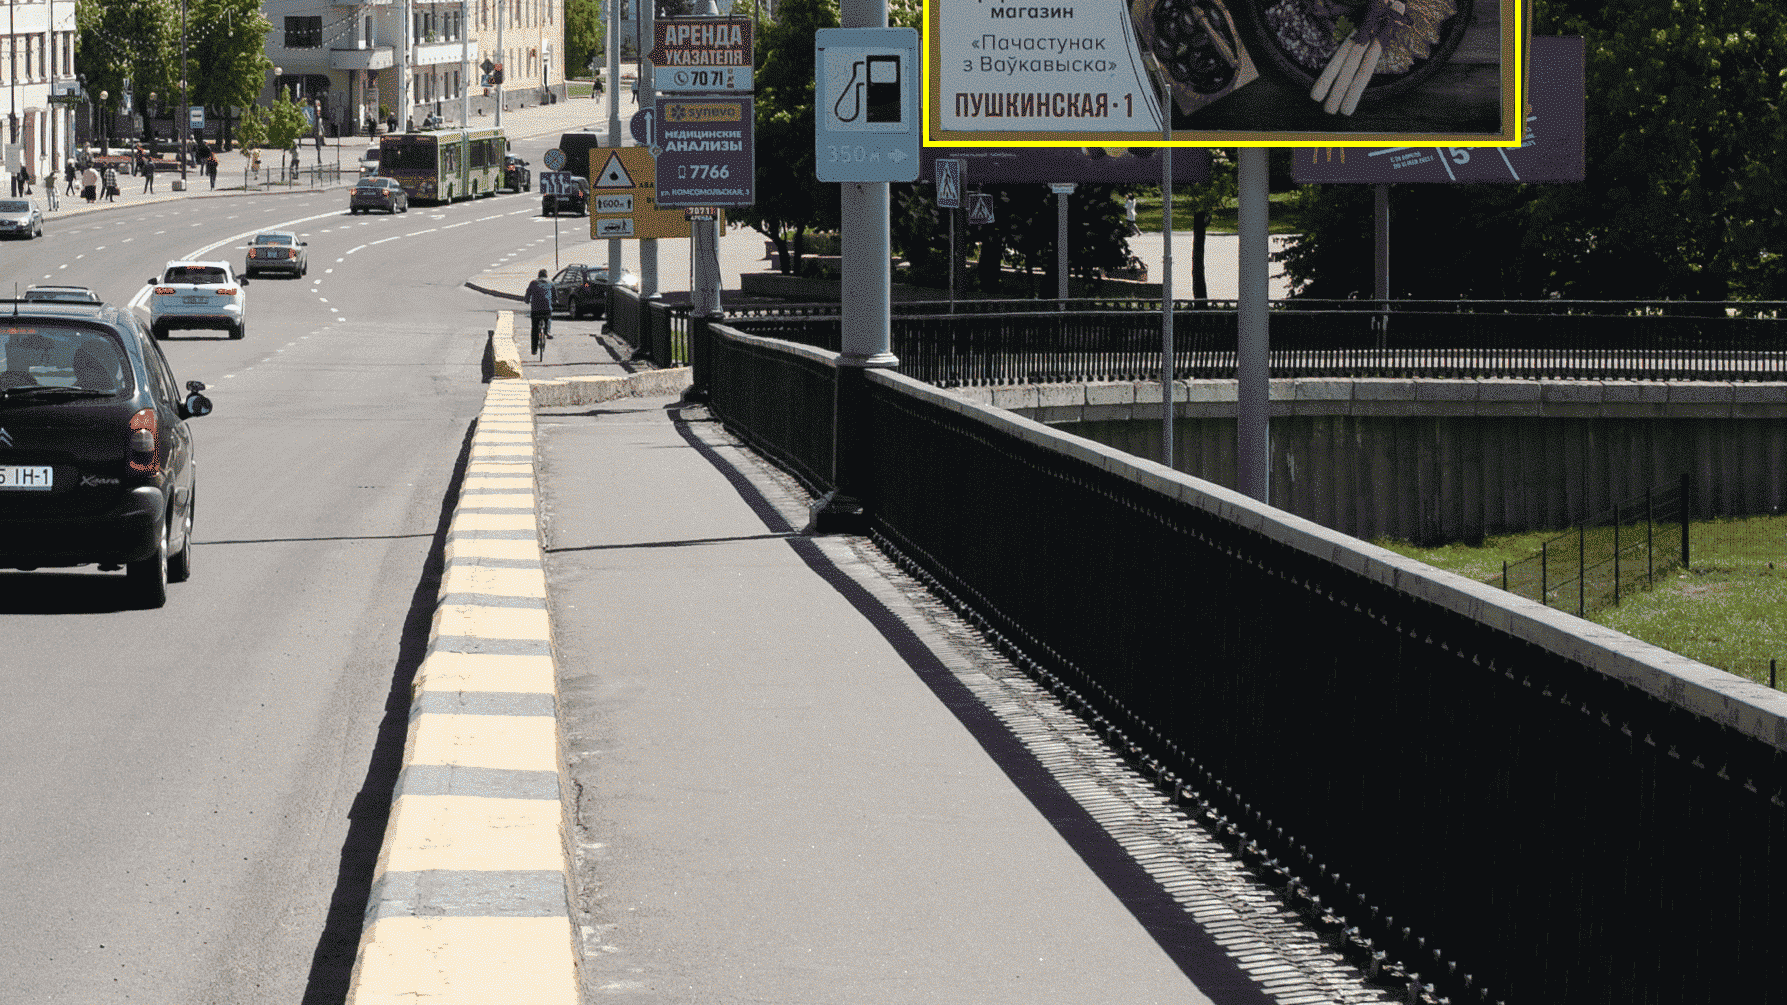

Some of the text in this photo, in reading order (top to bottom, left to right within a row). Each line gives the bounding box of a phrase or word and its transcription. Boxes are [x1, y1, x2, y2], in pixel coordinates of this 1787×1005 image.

[990, 7, 1074, 19] магазин
[664, 24, 743, 48] АРЕНДА
[971, 34, 1106, 55] «Пачастунак
[665, 50, 743, 65] УКАЗАТЕЛЯ
[963, 60, 973, 72] з
[664, 130, 743, 140] МЕДИЦИНСКИЕ
[665, 141, 743, 152] АНАЛИЗЫ
[689, 164, 730, 179] 7766
